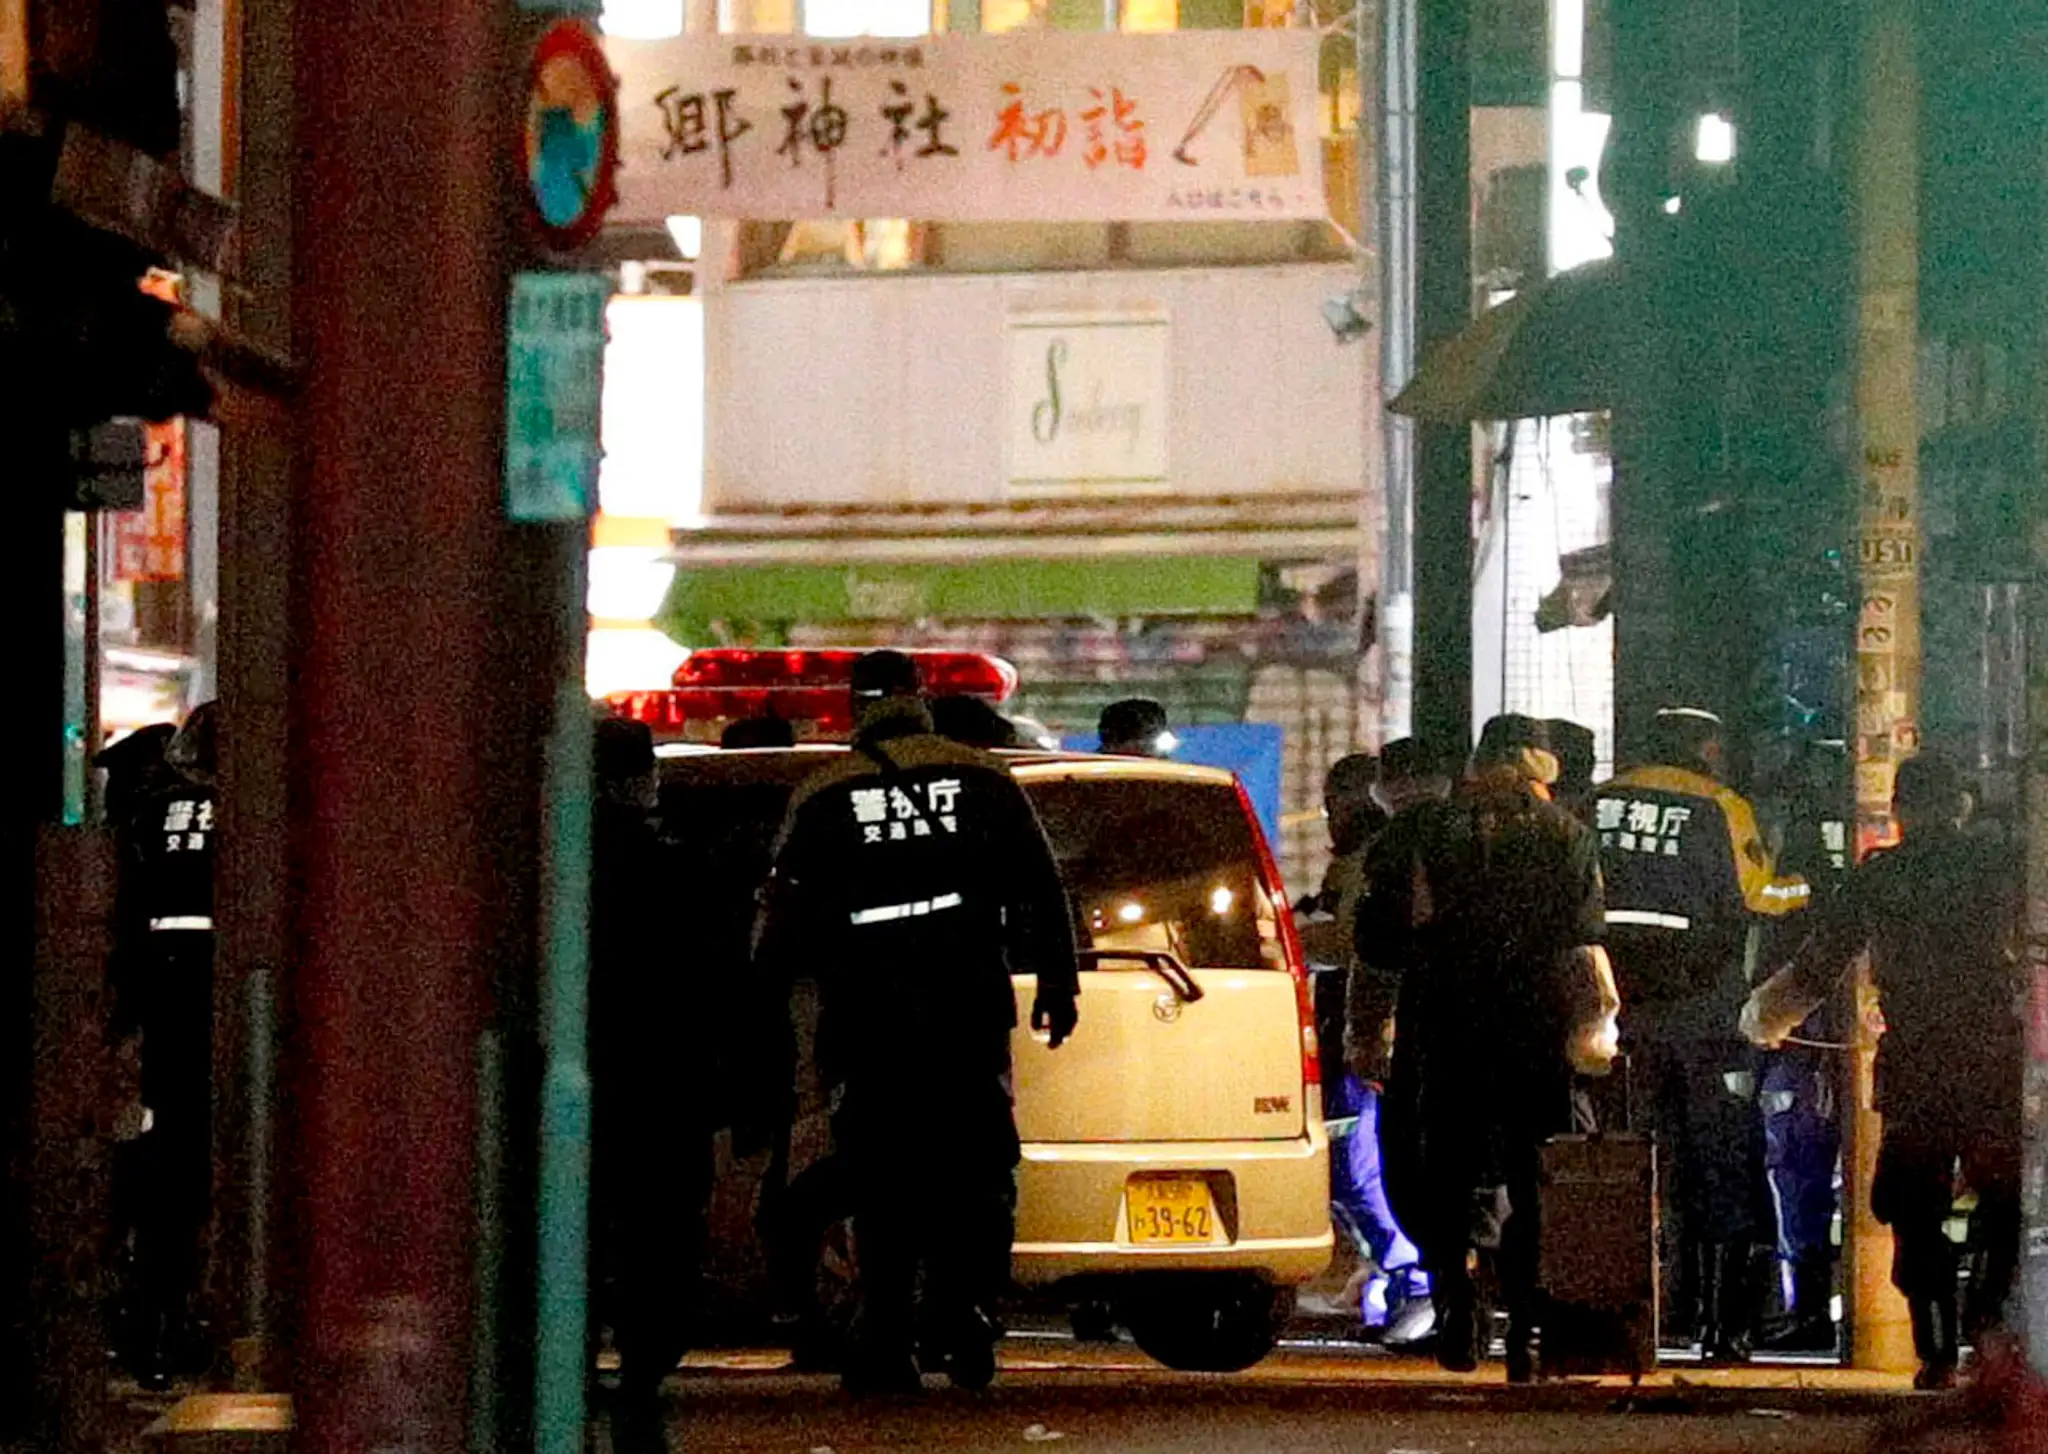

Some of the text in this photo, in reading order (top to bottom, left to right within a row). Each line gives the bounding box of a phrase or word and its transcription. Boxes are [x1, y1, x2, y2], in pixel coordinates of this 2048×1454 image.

[1596, 799, 1692, 837] 警視庁
[1147, 1205, 1210, 1238] 39-62
